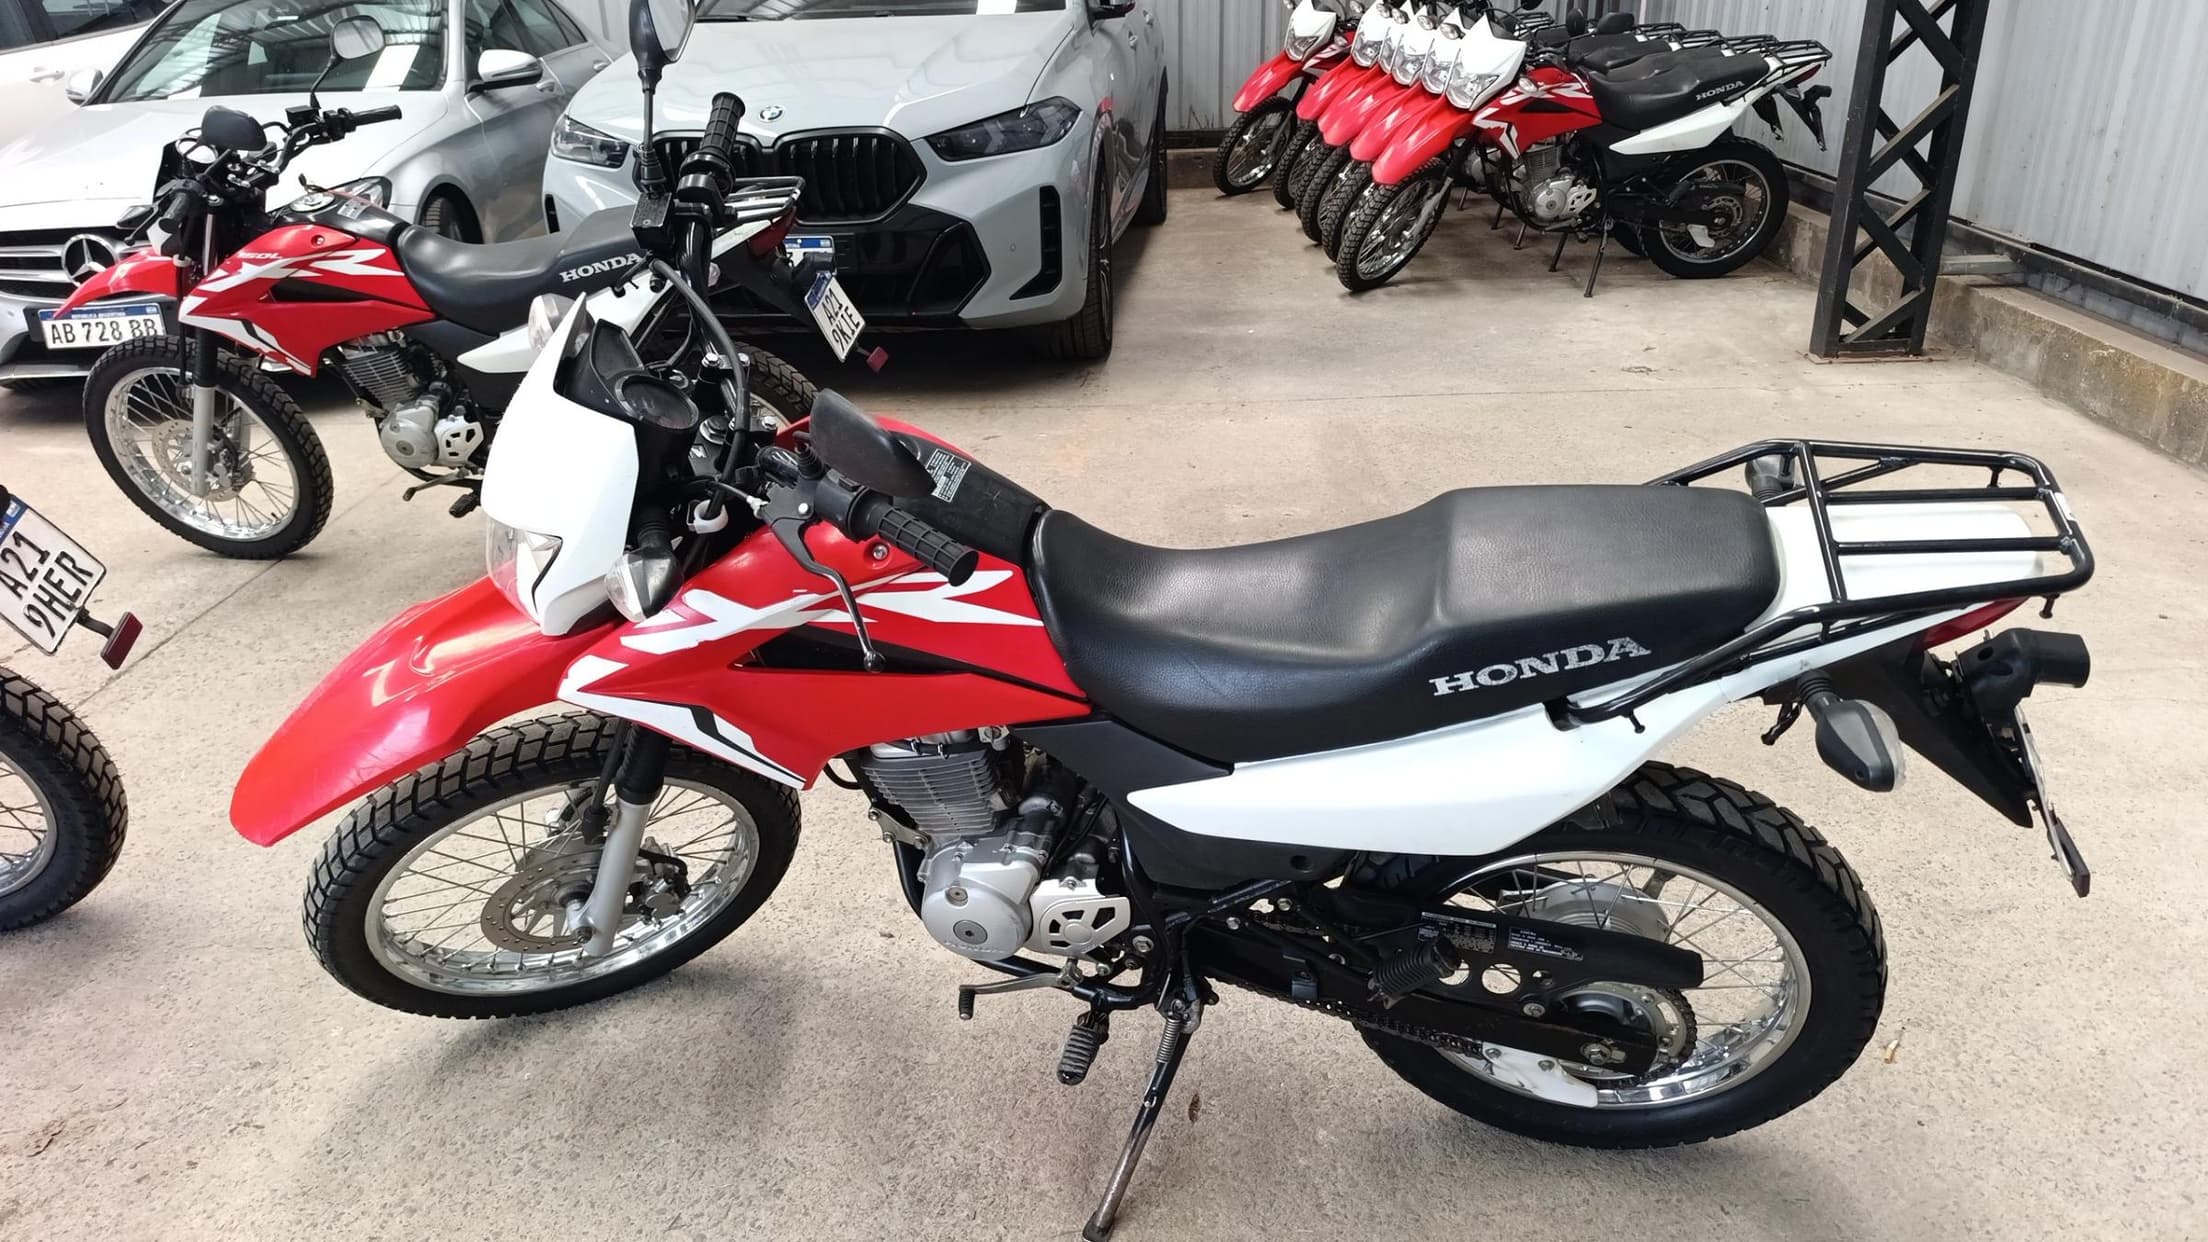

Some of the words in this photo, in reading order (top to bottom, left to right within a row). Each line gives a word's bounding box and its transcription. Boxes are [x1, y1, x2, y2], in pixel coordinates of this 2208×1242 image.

[1696, 81, 1745, 101] HONDA
[560, 253, 643, 283] HONDA
[821, 287, 844, 327] A21
[831, 305, 861, 353] 9KIE
[51, 322, 76, 345] AB
[81, 320, 123, 342] 728
[128, 318, 158, 338] BB
[0, 530, 50, 601] A21
[23, 550, 94, 639] 9HER
[1429, 636, 1651, 696] HONDA
